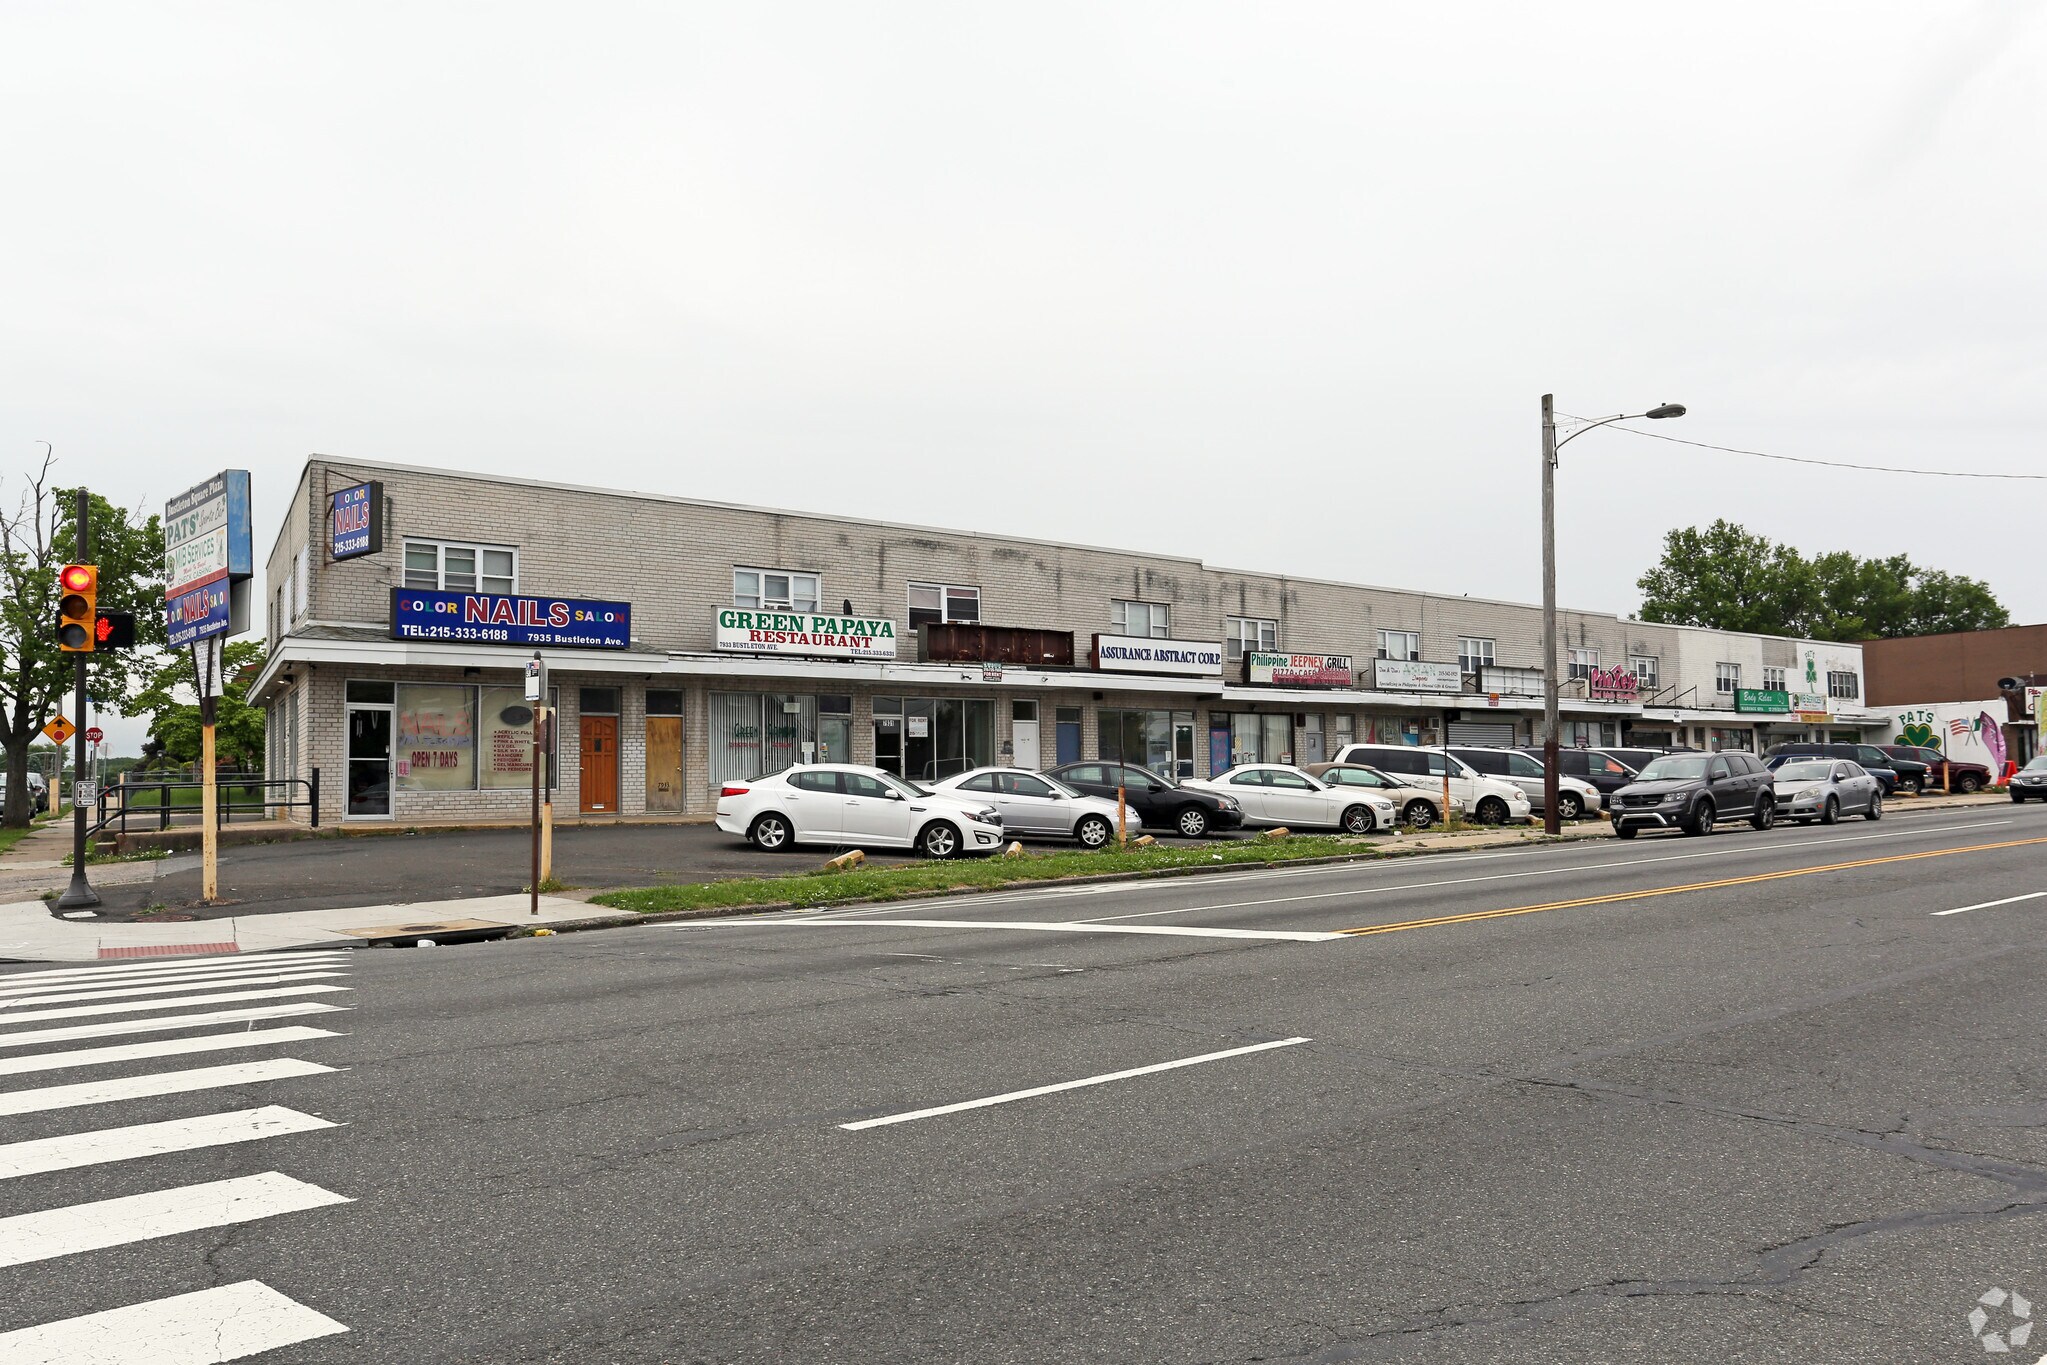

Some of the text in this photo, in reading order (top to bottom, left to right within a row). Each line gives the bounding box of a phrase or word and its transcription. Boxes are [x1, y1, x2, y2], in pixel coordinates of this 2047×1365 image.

[168, 480, 224, 517] Bustleton Square Plaza
[340, 489, 365, 505] COLOR
[335, 501, 369, 536] NAILS
[334, 535, 369, 554] 215-333-6188
[193, 566, 211, 579] CASHING
[183, 588, 209, 626] NAILS
[400, 596, 625, 628] COLOR NAILS SALON
[719, 610, 895, 638] GREEN PAPAYA
[401, 624, 624, 646] TEL:215-333-6188 7935 Bustleton Ave.
[749, 630, 873, 649] RESTAURANT
[719, 641, 732, 649] 7933
[732, 642, 766, 650] BUSTLETON
[1100, 645, 1221, 665] ASSURANCE ABSTRACT CORP.
[1251, 653, 1349, 672] Philippine JEEPNEY GRILL
[1272, 668, 1294, 678] PIZZA
[1320, 669, 1351, 680] CATERING
[1743, 691, 1773, 703] Body Relax
[1898, 708, 1934, 725] PAT'S
[86, 731, 103, 740] STOP
[411, 751, 458, 768] OPEN 7 DAYS
